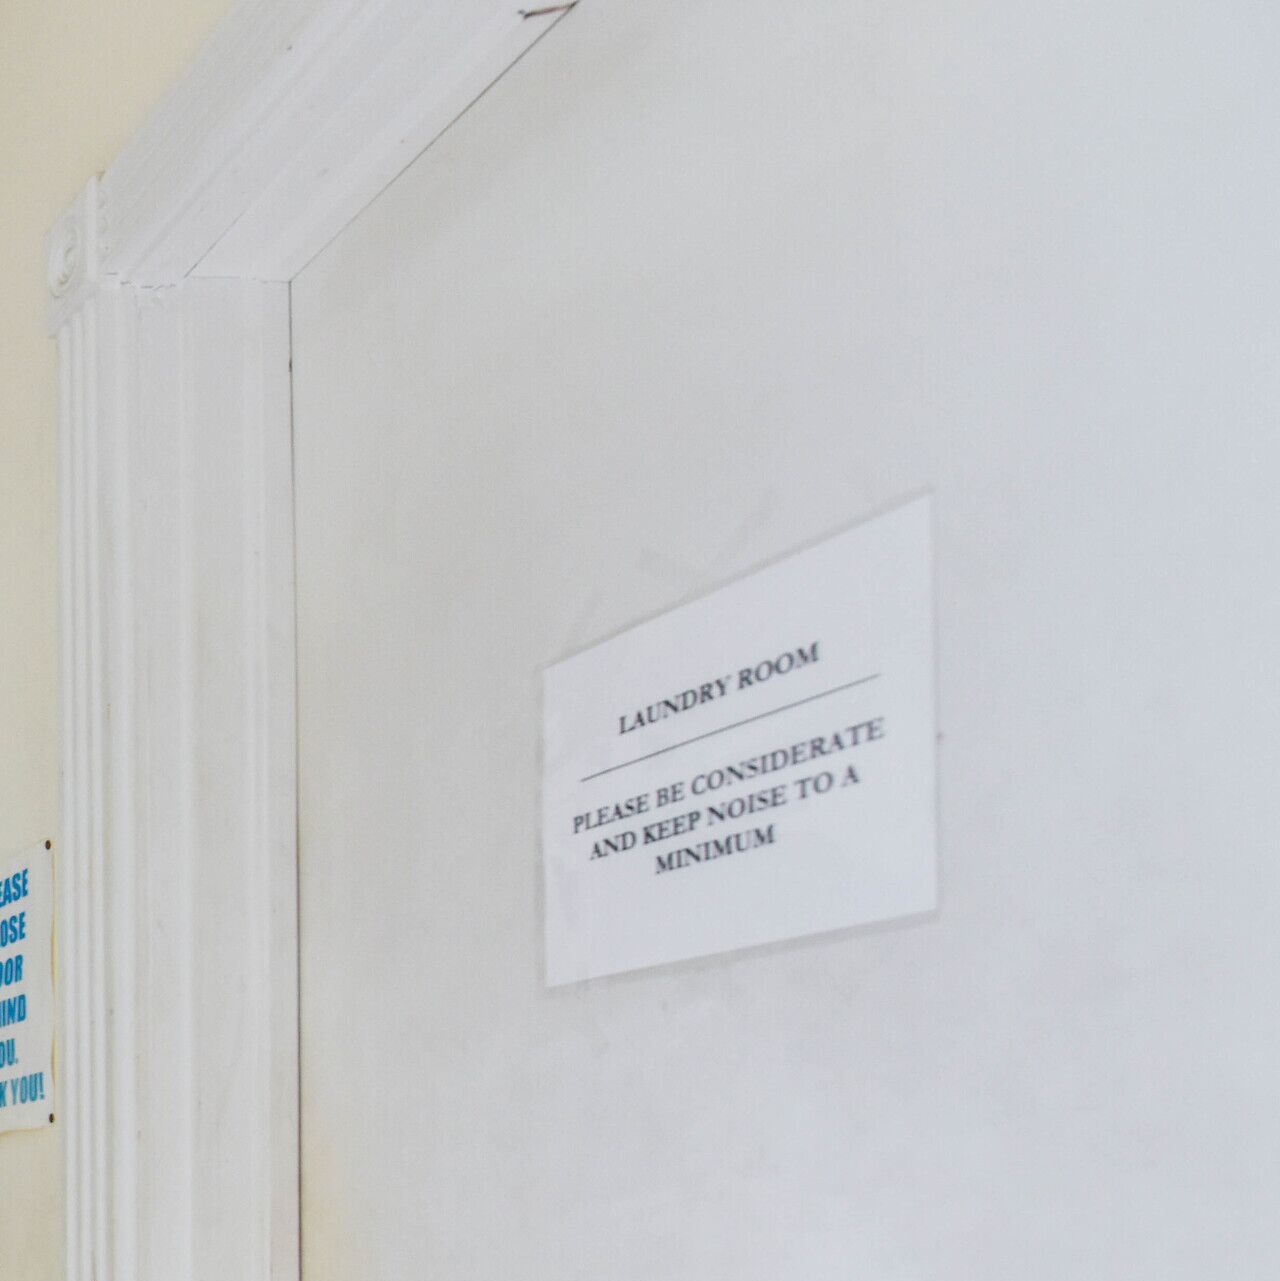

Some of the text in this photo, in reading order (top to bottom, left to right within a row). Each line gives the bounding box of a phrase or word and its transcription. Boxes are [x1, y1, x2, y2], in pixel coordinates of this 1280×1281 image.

[618, 641, 821, 736] LAUNDRY ROOM
[572, 716, 885, 835] PLEASE BE CONSIDERATE
[589, 765, 862, 861] AND KEEP NOISE TO A
[654, 823, 777, 875] MINIMUM
[10, 1071, 45, 1107] YOU!
